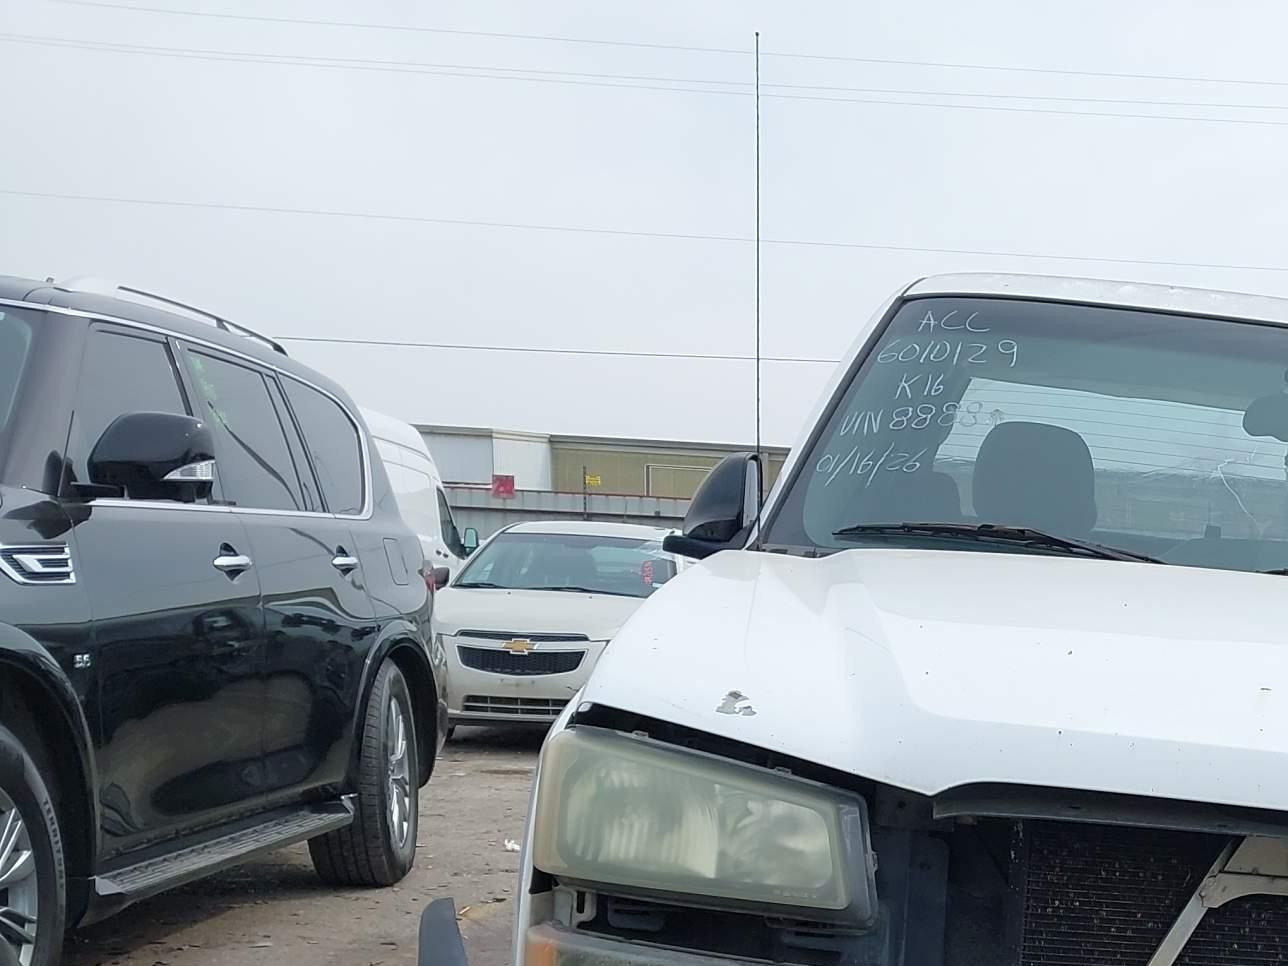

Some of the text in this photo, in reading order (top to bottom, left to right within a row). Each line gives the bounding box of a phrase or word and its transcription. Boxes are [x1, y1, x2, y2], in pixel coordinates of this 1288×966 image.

[917, 310, 990, 332] ACC
[876, 339, 1018, 367] 6010129
[839, 409, 883, 436] VIN
[815, 442, 928, 488] 01/16/26
